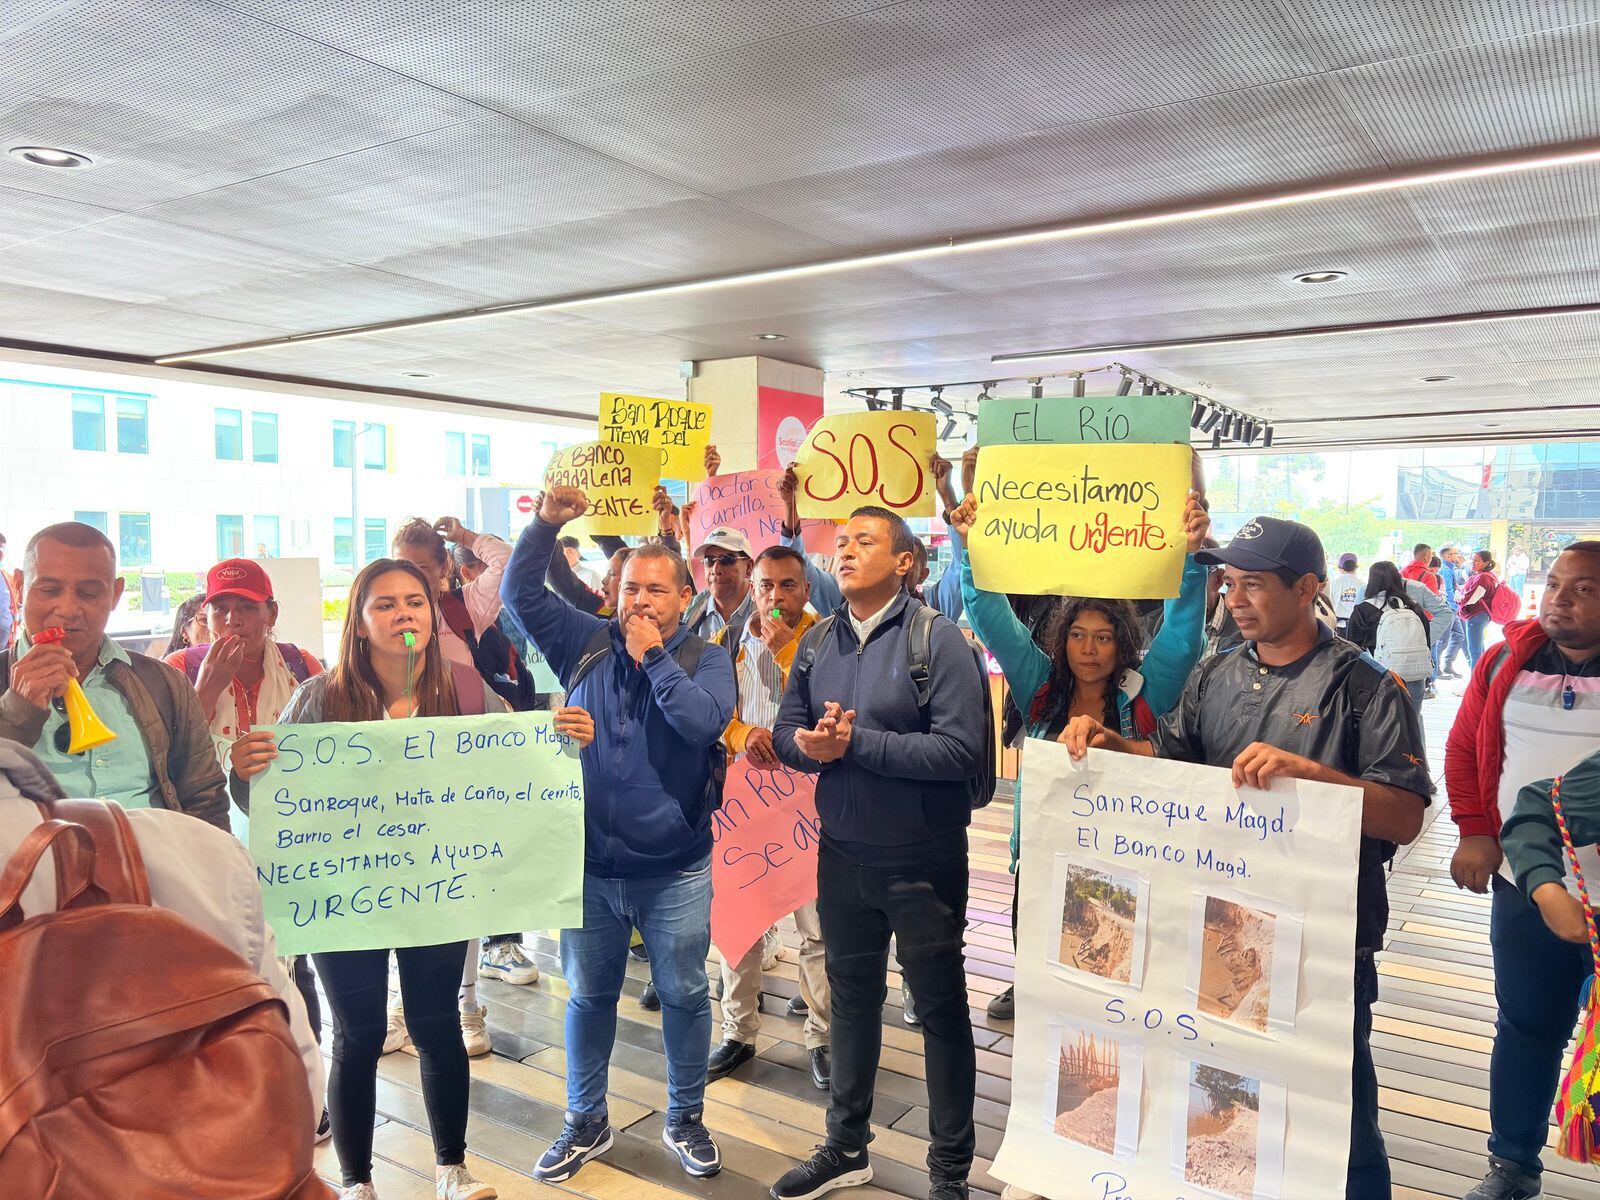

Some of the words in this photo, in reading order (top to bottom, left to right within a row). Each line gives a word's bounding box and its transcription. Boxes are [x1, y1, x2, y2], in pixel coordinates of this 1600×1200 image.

[610, 397, 648, 426] San
[650, 401, 706, 431] Roque
[571, 444, 625, 468] Banco
[804, 424, 929, 508] S.O.S.
[700, 475, 760, 506] Doctor
[980, 465, 1160, 511] Necesitamos
[700, 495, 765, 530] Carrillo,
[984, 508, 1058, 545] ayuda
[277, 733, 383, 773] S.O.S.
[404, 730, 436, 760] El
[456, 731, 526, 755] Banco
[441, 787, 456, 804] de
[515, 782, 532, 801] el
[275, 829, 332, 849] Barrio
[343, 823, 361, 840] el
[1225, 801, 1294, 841] Magd.
[1077, 826, 1100, 851] El
[1113, 833, 1186, 863] Banco
[256, 851, 415, 887] NECESITAMOS
[723, 842, 794, 890] Se
[1104, 998, 1217, 1048] S.O.S.
